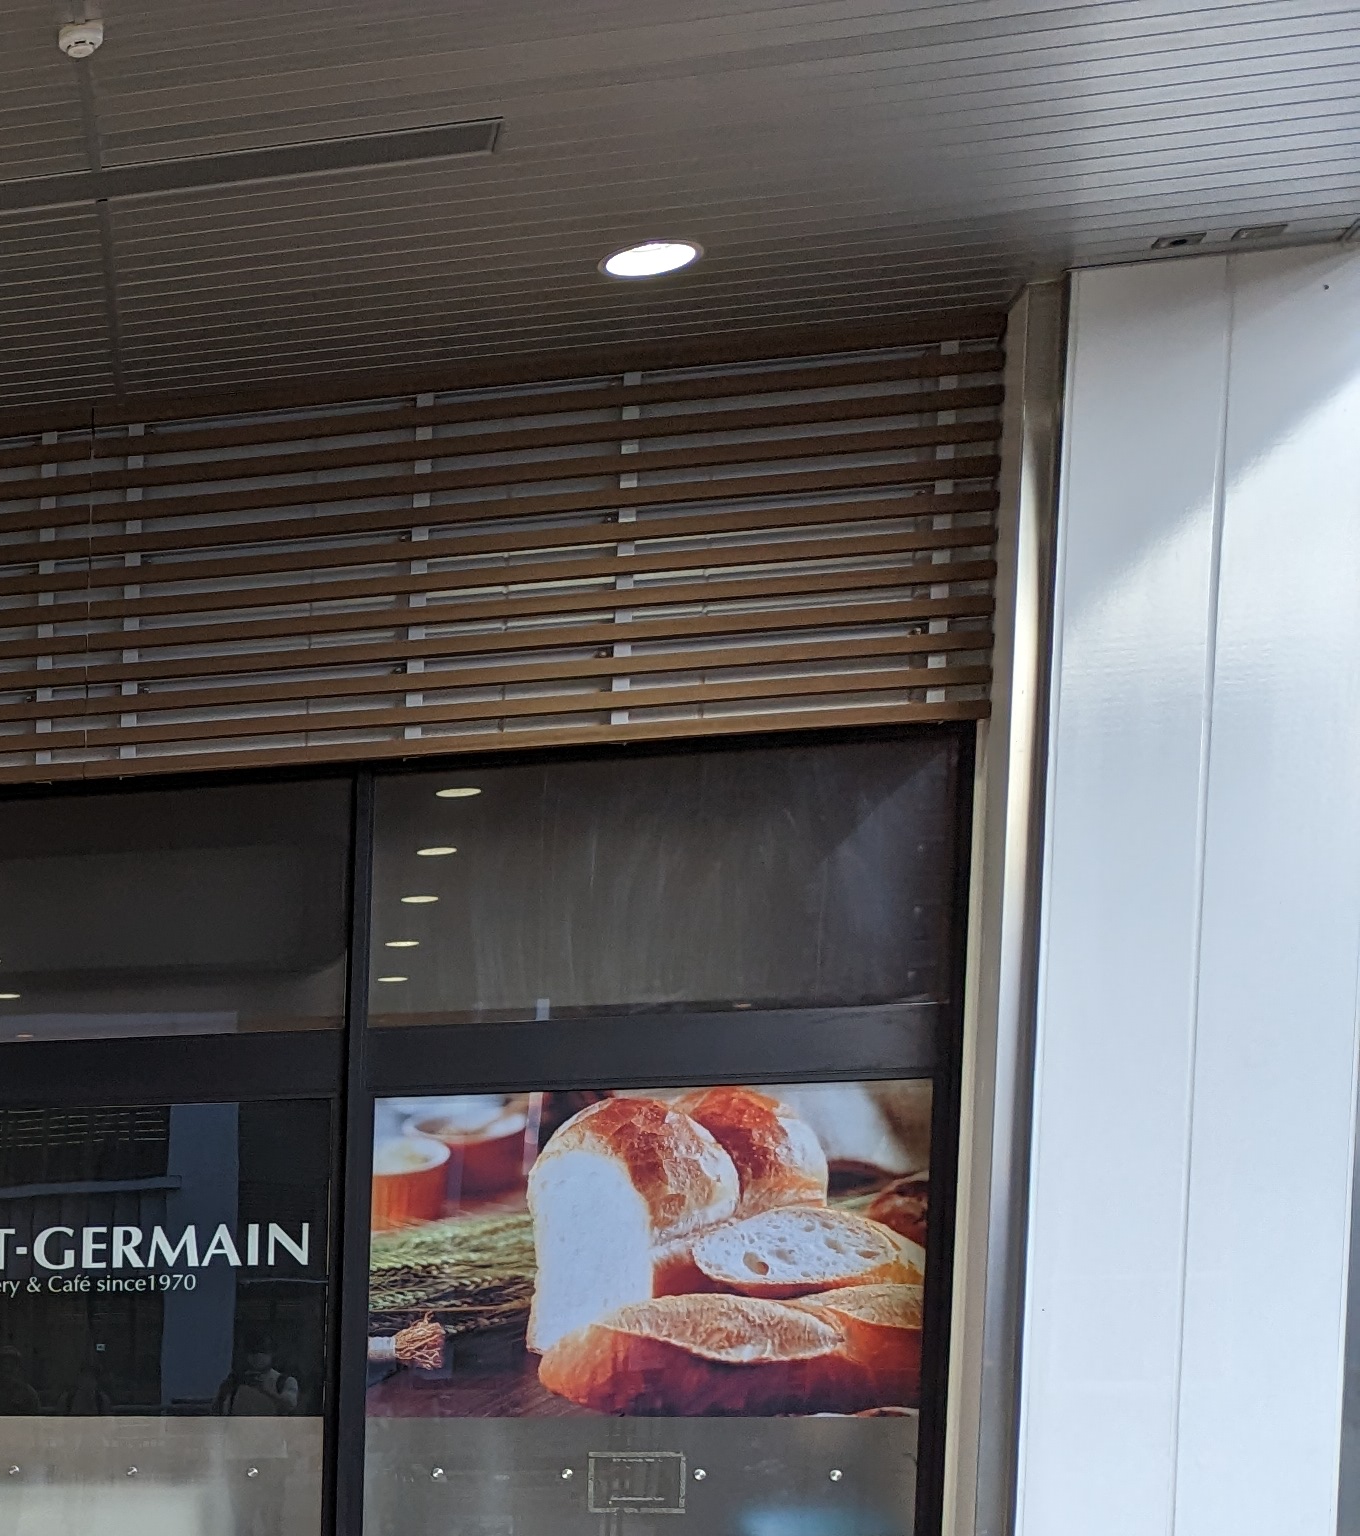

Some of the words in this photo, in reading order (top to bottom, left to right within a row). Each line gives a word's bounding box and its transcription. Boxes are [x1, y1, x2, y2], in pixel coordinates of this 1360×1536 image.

[26, 1276, 41, 1293] &
[48, 1274, 91, 1293] Café
[96, 1274, 197, 1293] since1970
